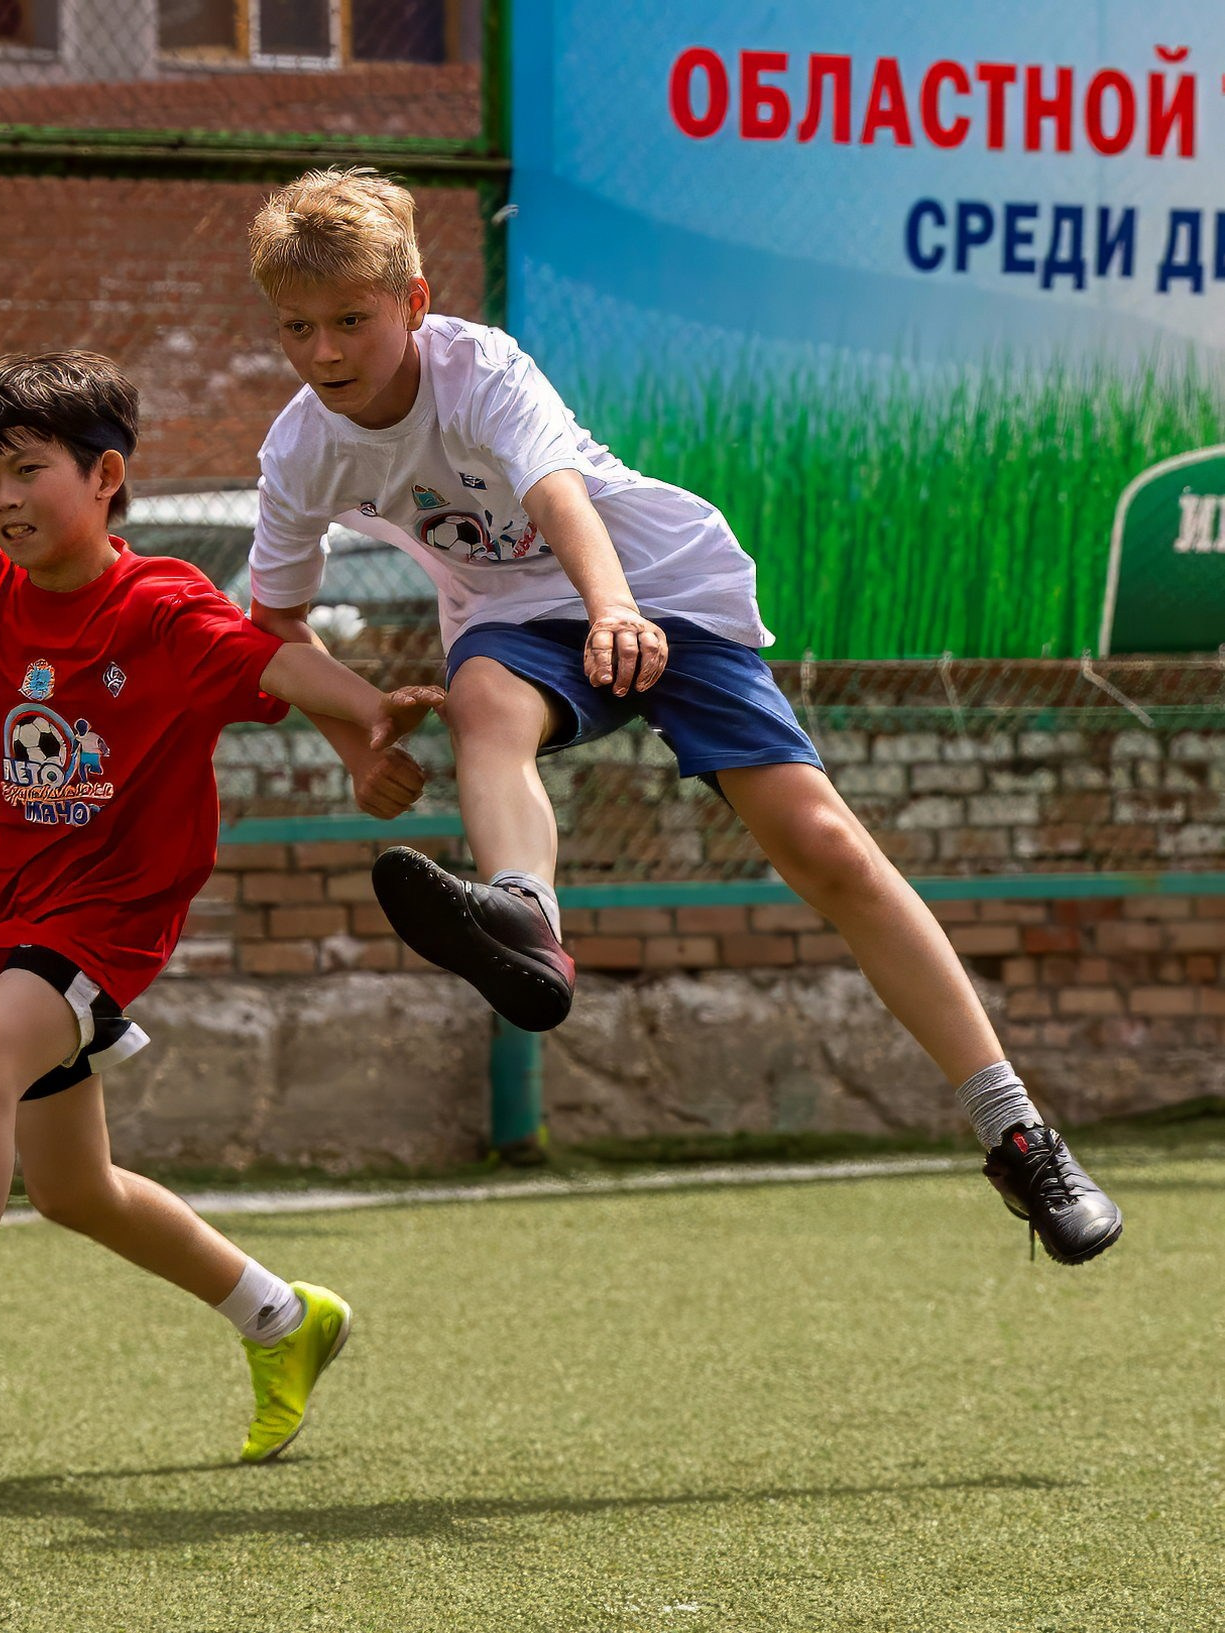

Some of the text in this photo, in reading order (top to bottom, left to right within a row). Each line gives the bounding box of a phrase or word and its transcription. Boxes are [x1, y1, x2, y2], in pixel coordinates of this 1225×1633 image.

[669, 45, 1196, 159] ОБЛАСТНОЙ
[904, 198, 1138, 291] СРЕДИ
[2, 757, 66, 790] ЛЕТО
